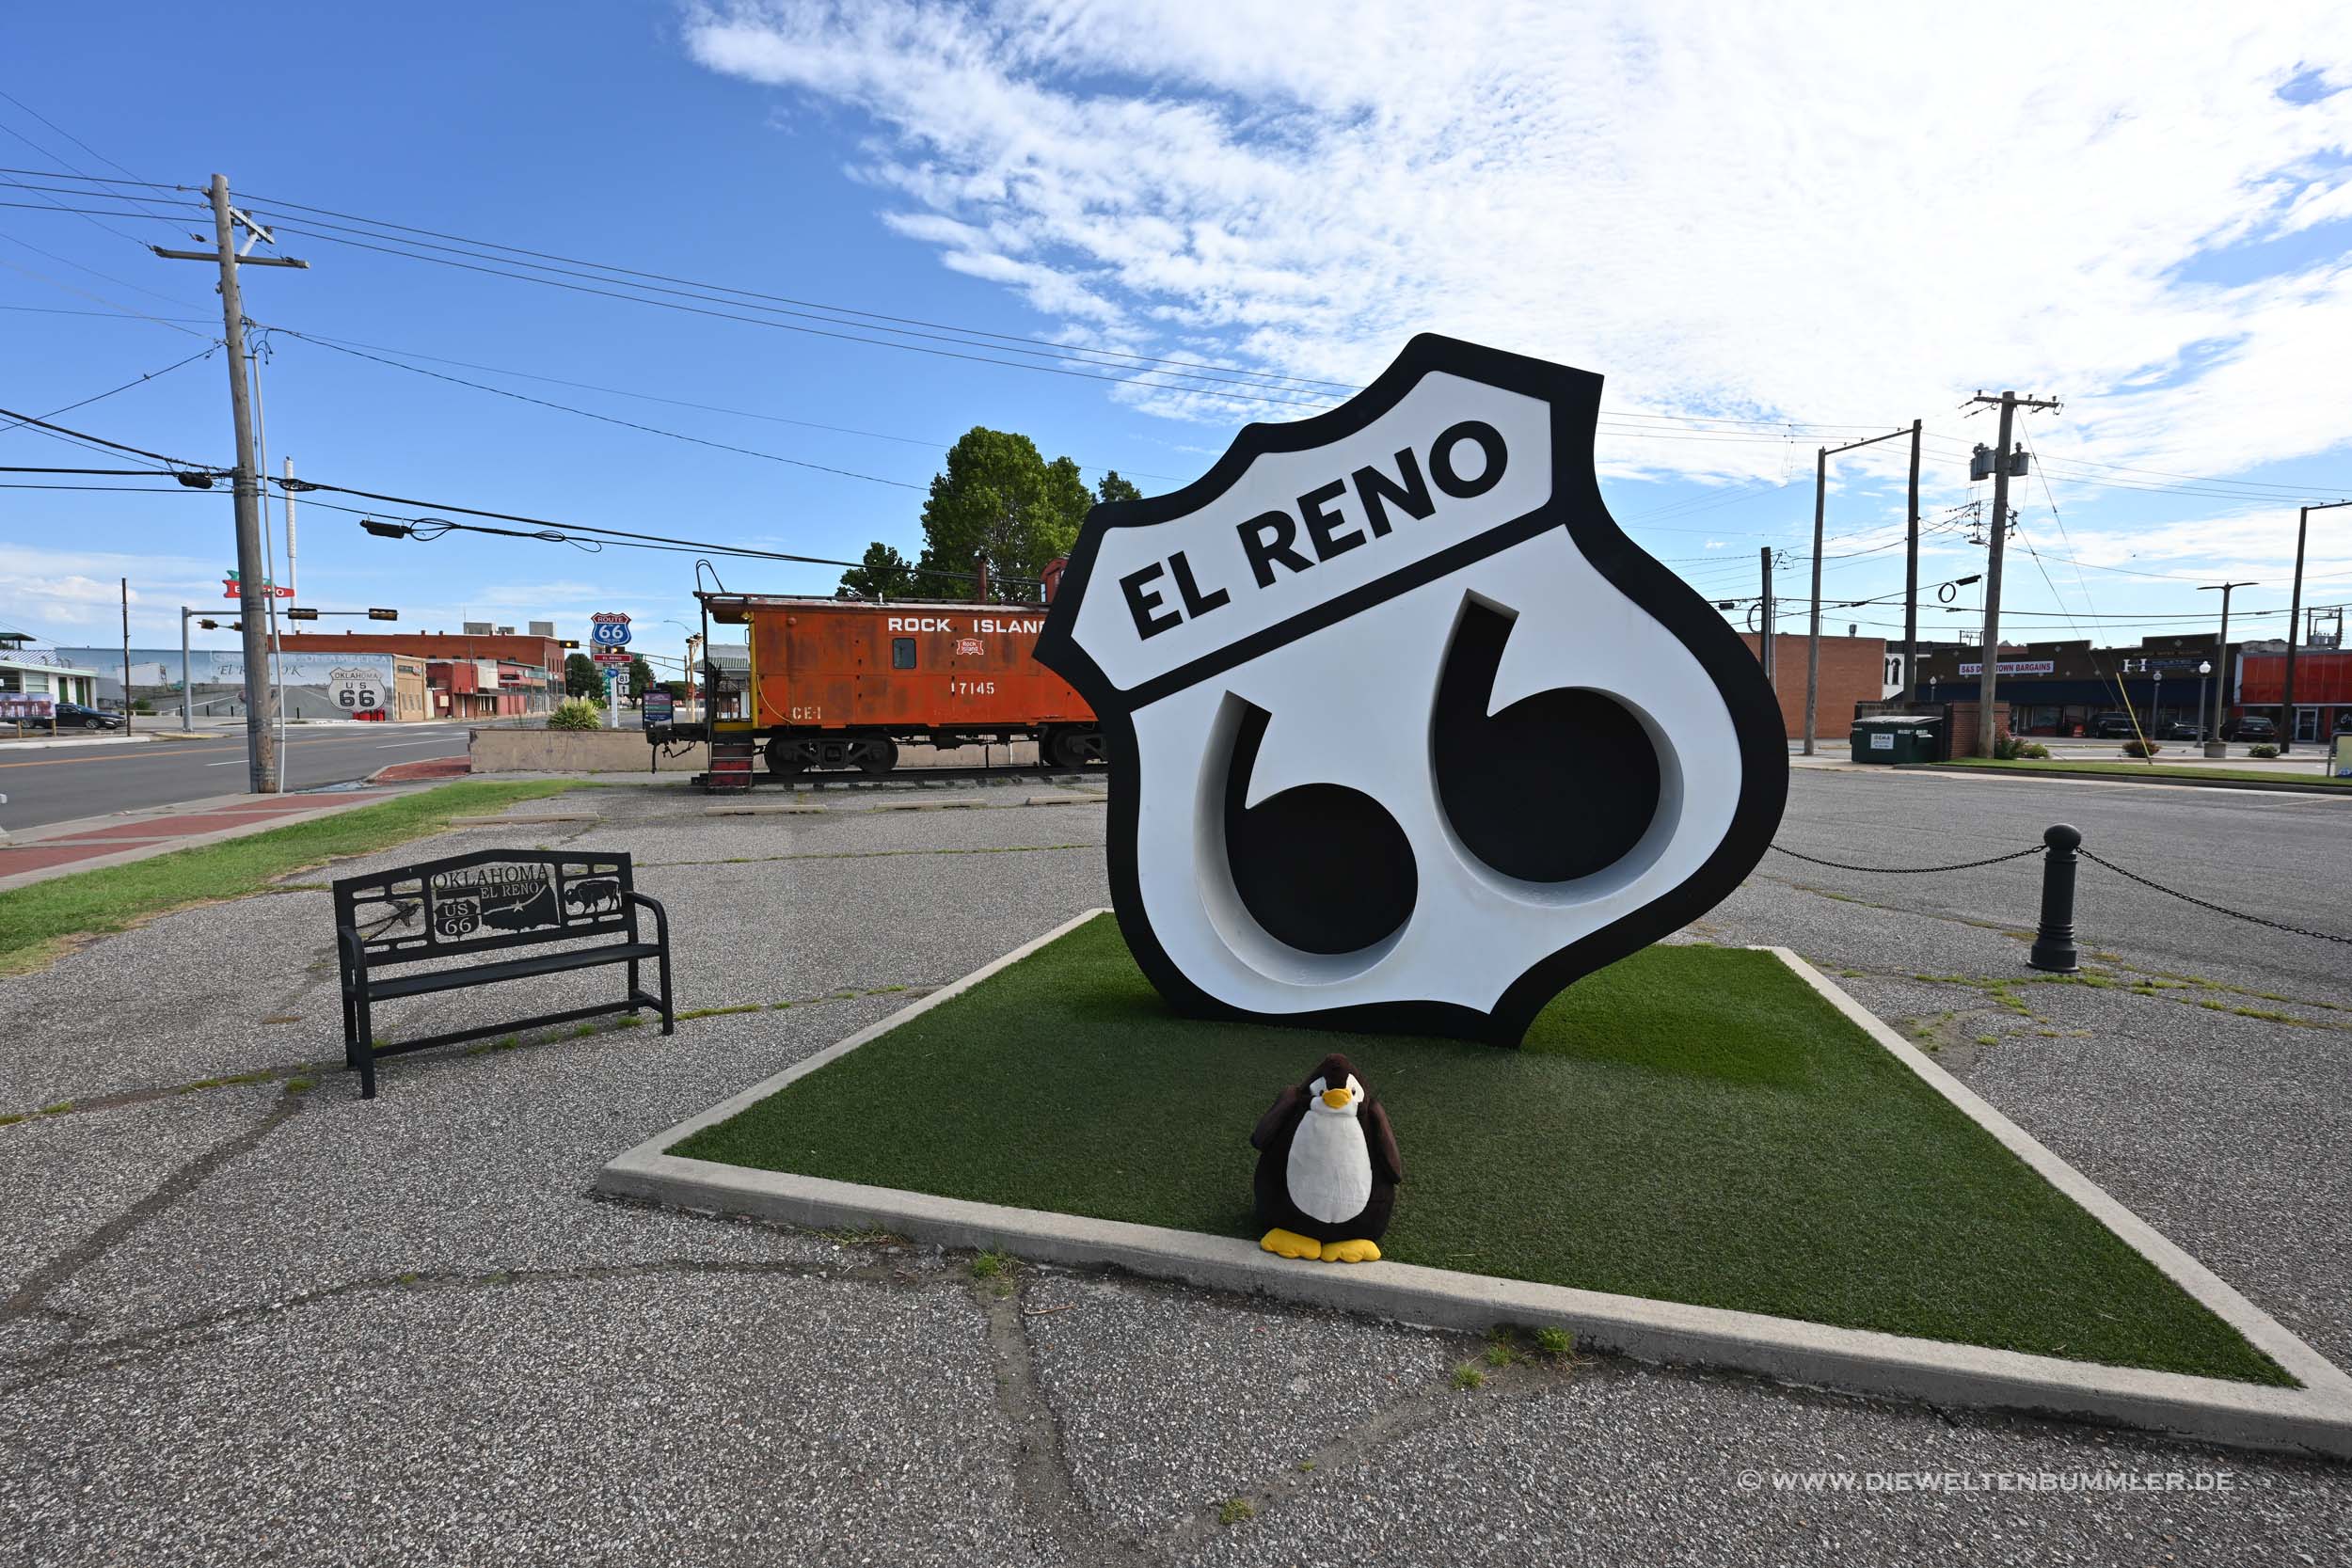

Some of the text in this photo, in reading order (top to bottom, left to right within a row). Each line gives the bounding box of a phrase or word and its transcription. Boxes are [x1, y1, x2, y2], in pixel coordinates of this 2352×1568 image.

[1120, 420, 1508, 641] EL RENO
[599, 625, 624, 639] 66
[888, 617, 952, 633] ROCK
[2015, 662, 2051, 672] BARGAINS
[951, 682, 994, 695] 17145
[340, 689, 375, 706] 66
[1194, 588, 1685, 986] 66
[434, 863, 548, 889] OKLAHOMA
[481, 881, 539, 899] EL RENO
[444, 903, 469, 917] US
[445, 917, 472, 935] 66
